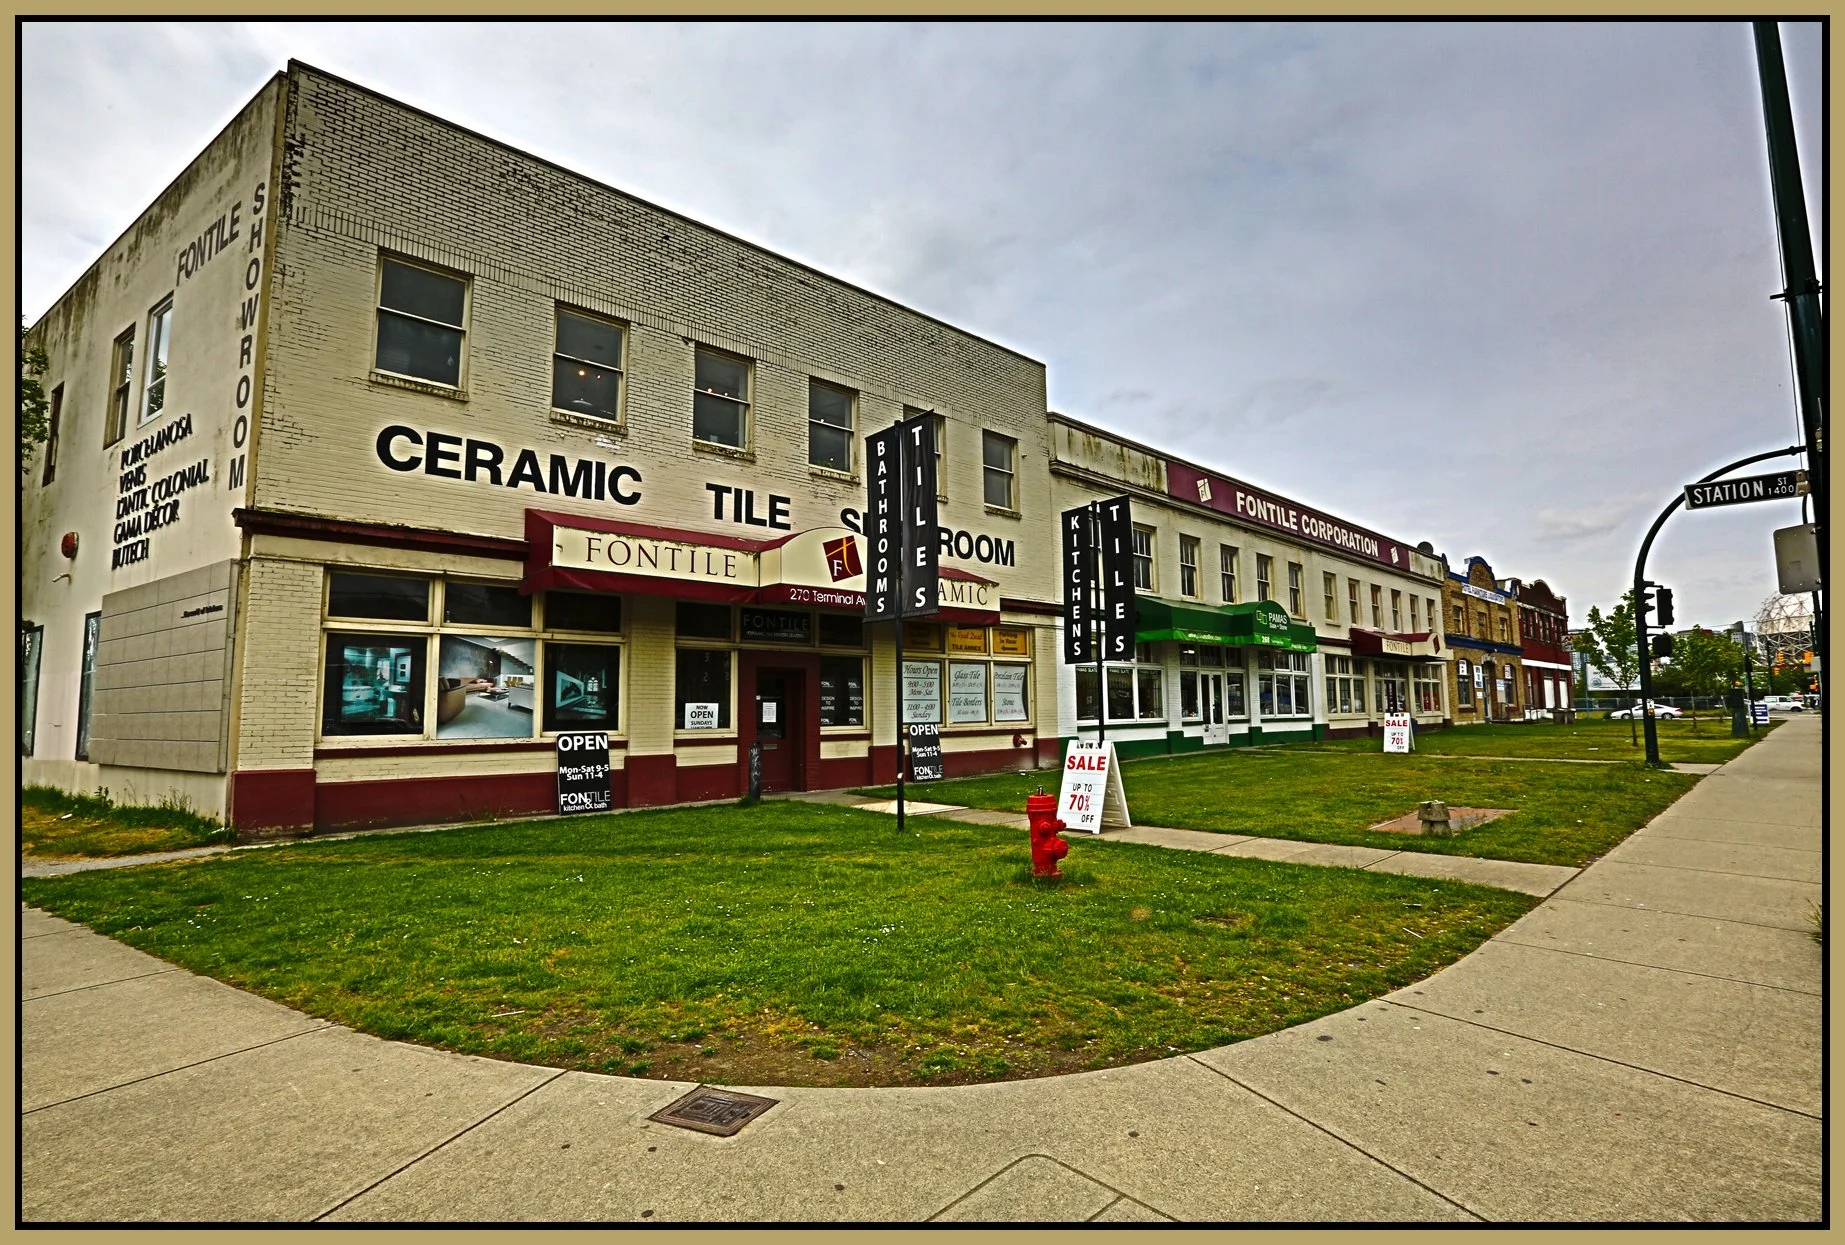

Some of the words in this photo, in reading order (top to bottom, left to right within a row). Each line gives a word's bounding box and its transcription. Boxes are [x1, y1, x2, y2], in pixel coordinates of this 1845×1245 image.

[176, 201, 242, 287] FONTILE
[229, 182, 265, 490] SHOWROOM
[121, 413, 193, 470] PORCELANOSA
[120, 463, 147, 494] VENIS
[151, 458, 209, 503] COLONIAL
[1777, 477, 1787, 486] ST
[376, 425, 642, 505] CERAMIC
[706, 482, 791, 530] TILE
[840, 507, 1015, 567] SROOM
[1693, 480, 1764, 504] STATION
[1768, 485, 1795, 495] 1400
[113, 515, 142, 544] GAMA
[144, 499, 180, 533] DÉCOR
[912, 426, 927, 608] TILES
[1236, 491, 1298, 531] FONTILE
[1302, 515, 1379, 557] CORPORATION
[877, 440, 888, 613] BATHROOMS
[111, 538, 150, 571] BUTECH
[586, 537, 737, 578] FONTILE
[1071, 515, 1081, 656] KITCHENS
[1109, 505, 1125, 653] TILES
[790, 588, 810, 602] 270
[813, 590, 854, 605] Terminal
[1268, 612, 1287, 624] PAMAS
[1386, 640, 1409, 654] FONTILE
[904, 664, 922, 675] Hours
[923, 665, 938, 678] Open
[690, 710, 714, 719] OPEN
[910, 711, 931, 720] Sunday
[1385, 719, 1408, 727] SALE
[910, 724, 939, 736] OPEN
[558, 735, 608, 752] OPEN
[559, 765, 595, 774] Mon-Sat
[595, 764, 609, 772] 9-5
[1067, 755, 1107, 771] SALE
[585, 771, 603, 780] 11-4
[1072, 783, 1081, 791] UP
[1084, 784, 1093, 792] TO
[563, 804, 585, 812] kitchen
[585, 798, 594, 810] &
[1069, 794, 1091, 811] 70%
[1081, 814, 1095, 823] OFF
